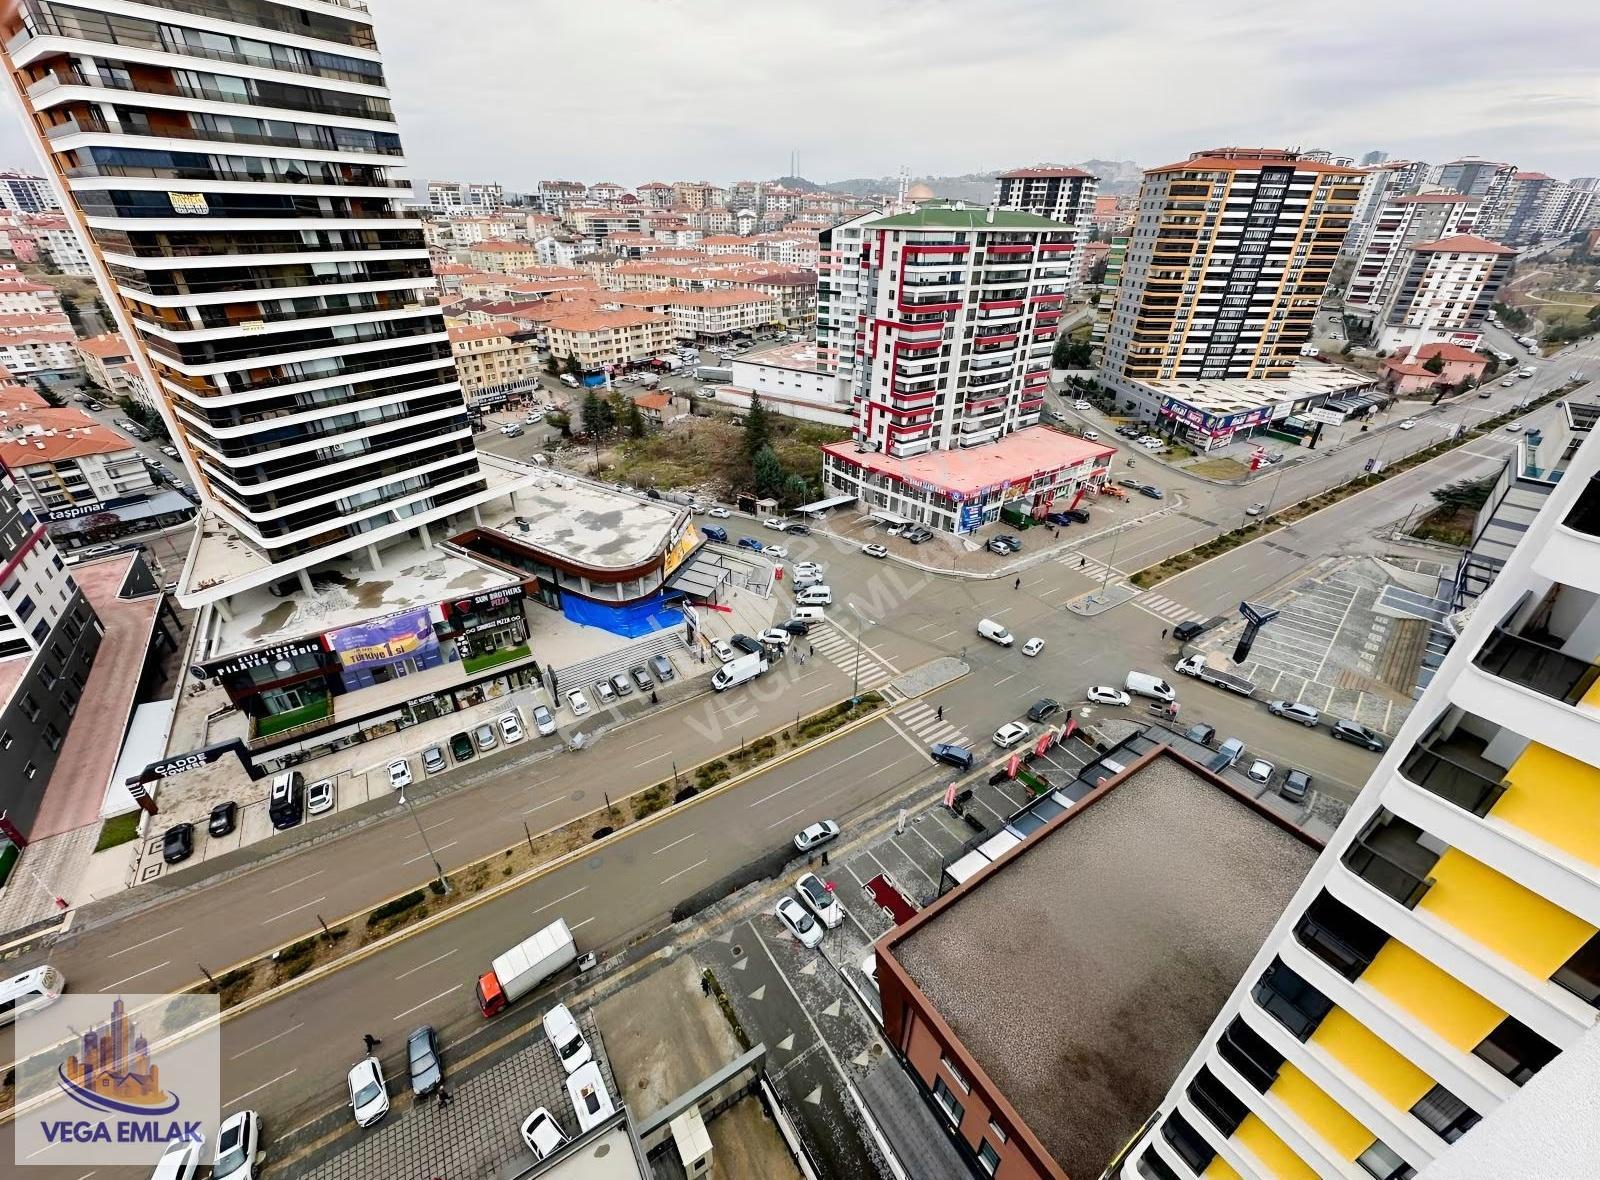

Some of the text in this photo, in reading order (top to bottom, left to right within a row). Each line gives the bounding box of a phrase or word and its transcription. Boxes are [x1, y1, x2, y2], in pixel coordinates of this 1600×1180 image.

[475, 586, 522, 604] SUN BROTHERS
[154, 752, 208, 773] CADDE
[162, 760, 208, 778] TOWERS
